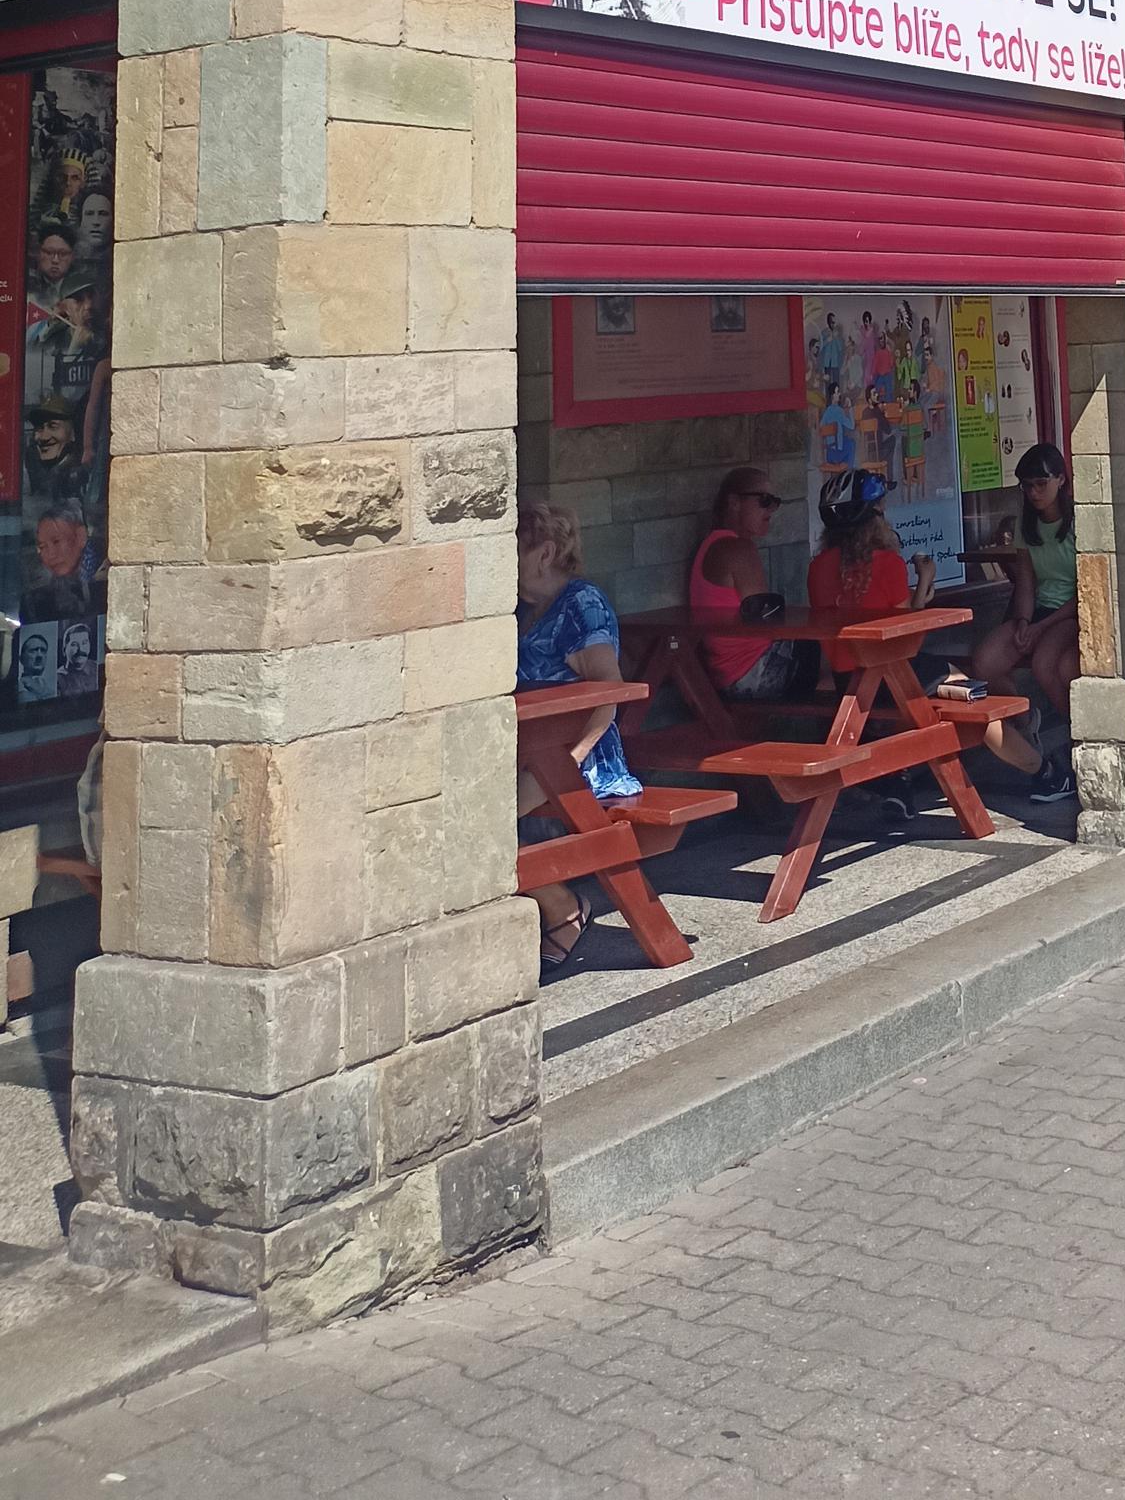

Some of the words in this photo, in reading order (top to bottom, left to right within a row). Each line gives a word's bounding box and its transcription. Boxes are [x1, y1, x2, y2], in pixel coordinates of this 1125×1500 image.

[894, 2, 970, 71] blíže,
[978, 20, 1039, 82] tady
[1048, 42, 1075, 81] se
